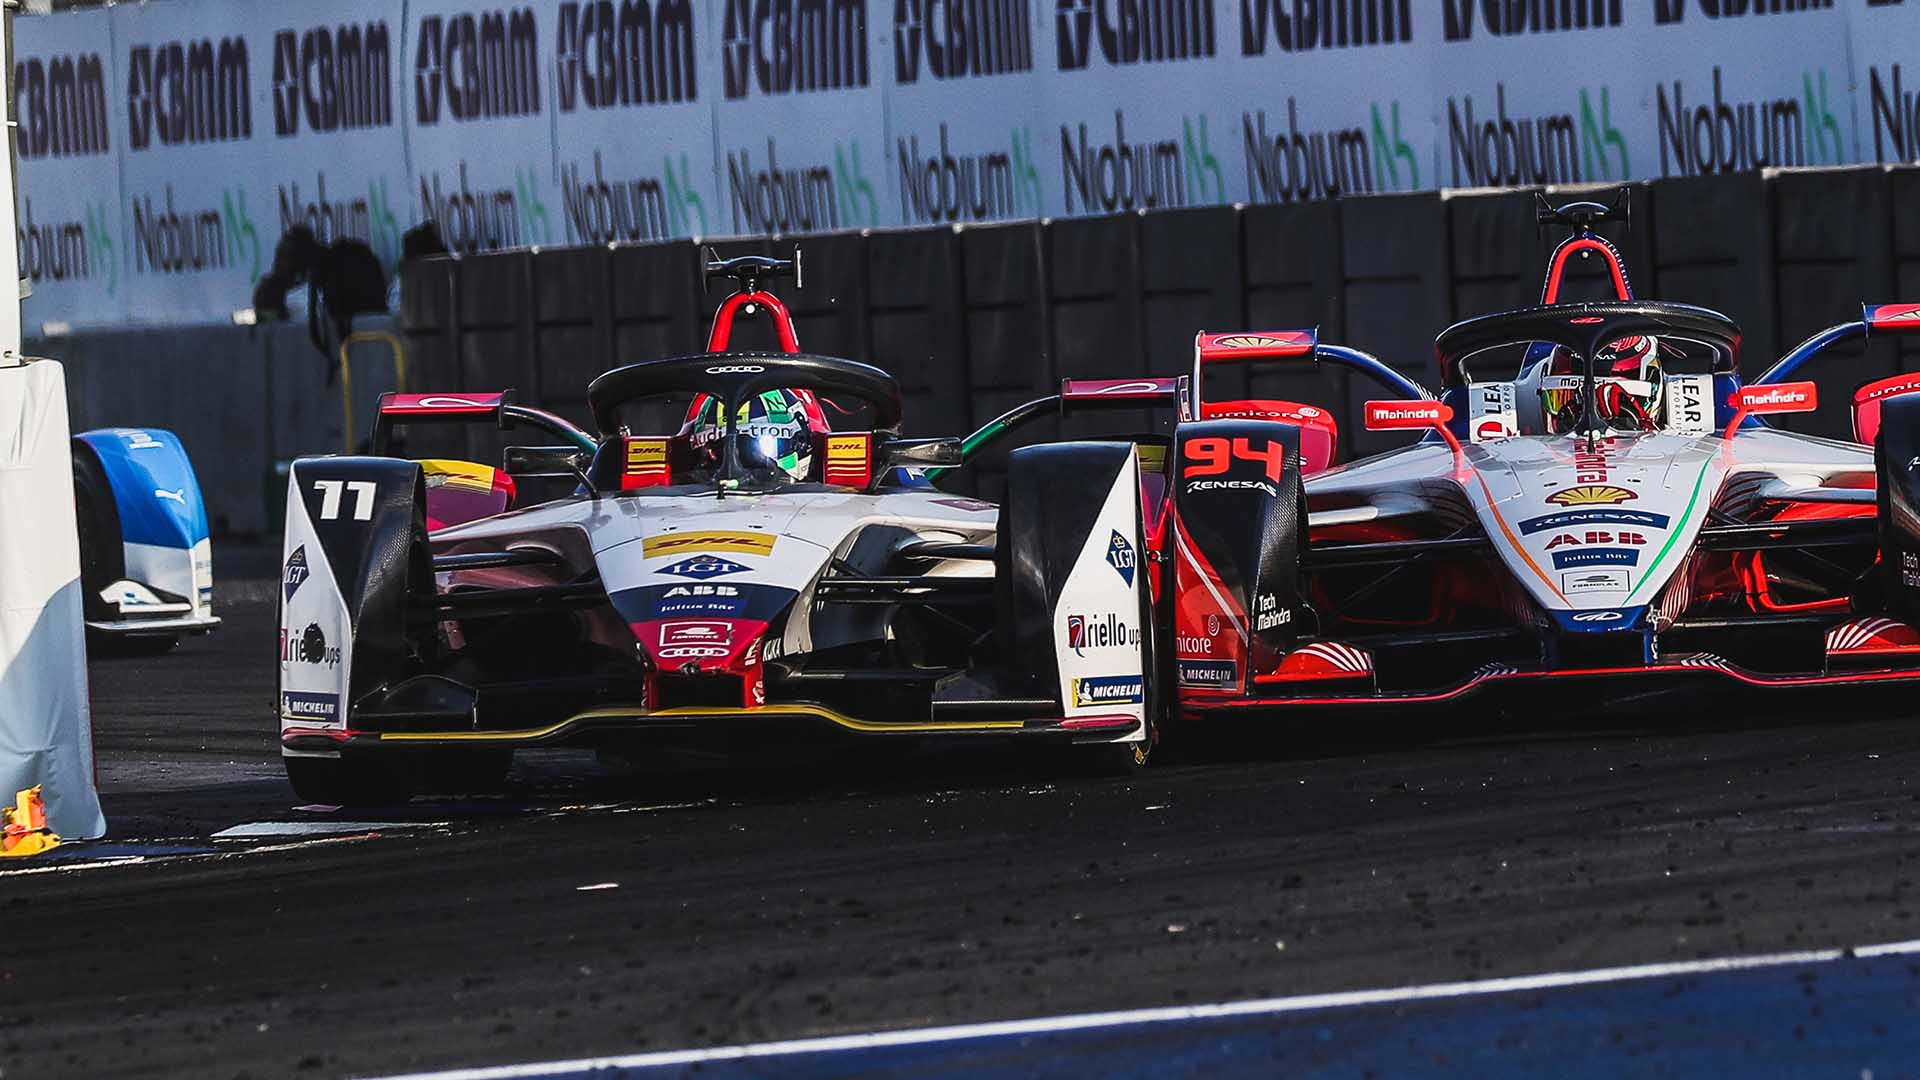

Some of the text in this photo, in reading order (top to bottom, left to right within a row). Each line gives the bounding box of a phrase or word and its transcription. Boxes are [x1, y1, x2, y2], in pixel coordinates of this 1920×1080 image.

[580, 0, 697, 109] CBMM
[445, 8, 540, 122] CBMM
[300, 19, 391, 134] CBMM
[154, 36, 251, 146] CBMM
[1483, 384, 1502, 414] LEA
[1681, 376, 1702, 422] LEAR
[1743, 389, 1805, 405] Mahindra
[1209, 410, 1303, 420] umicore
[1374, 408, 1439, 420] Mahindra
[1184, 437, 1284, 484] 94
[1186, 480, 1278, 497] RENESAS
[313, 480, 377, 521] 11
[1544, 531, 1648, 550] ABB
[673, 563, 738, 574] LGT
[1111, 549, 1135, 569] LGT
[663, 586, 739, 598] ABB
[1259, 593, 1277, 612] Tech
[1257, 608, 1291, 631] Mahindra
[1087, 613, 1127, 648] riello
[324, 646, 341, 670] ups
[1186, 668, 1232, 681] MICHELIN
[1093, 683, 1142, 698] MICHELIN
[291, 700, 335, 714] MICHELIN
